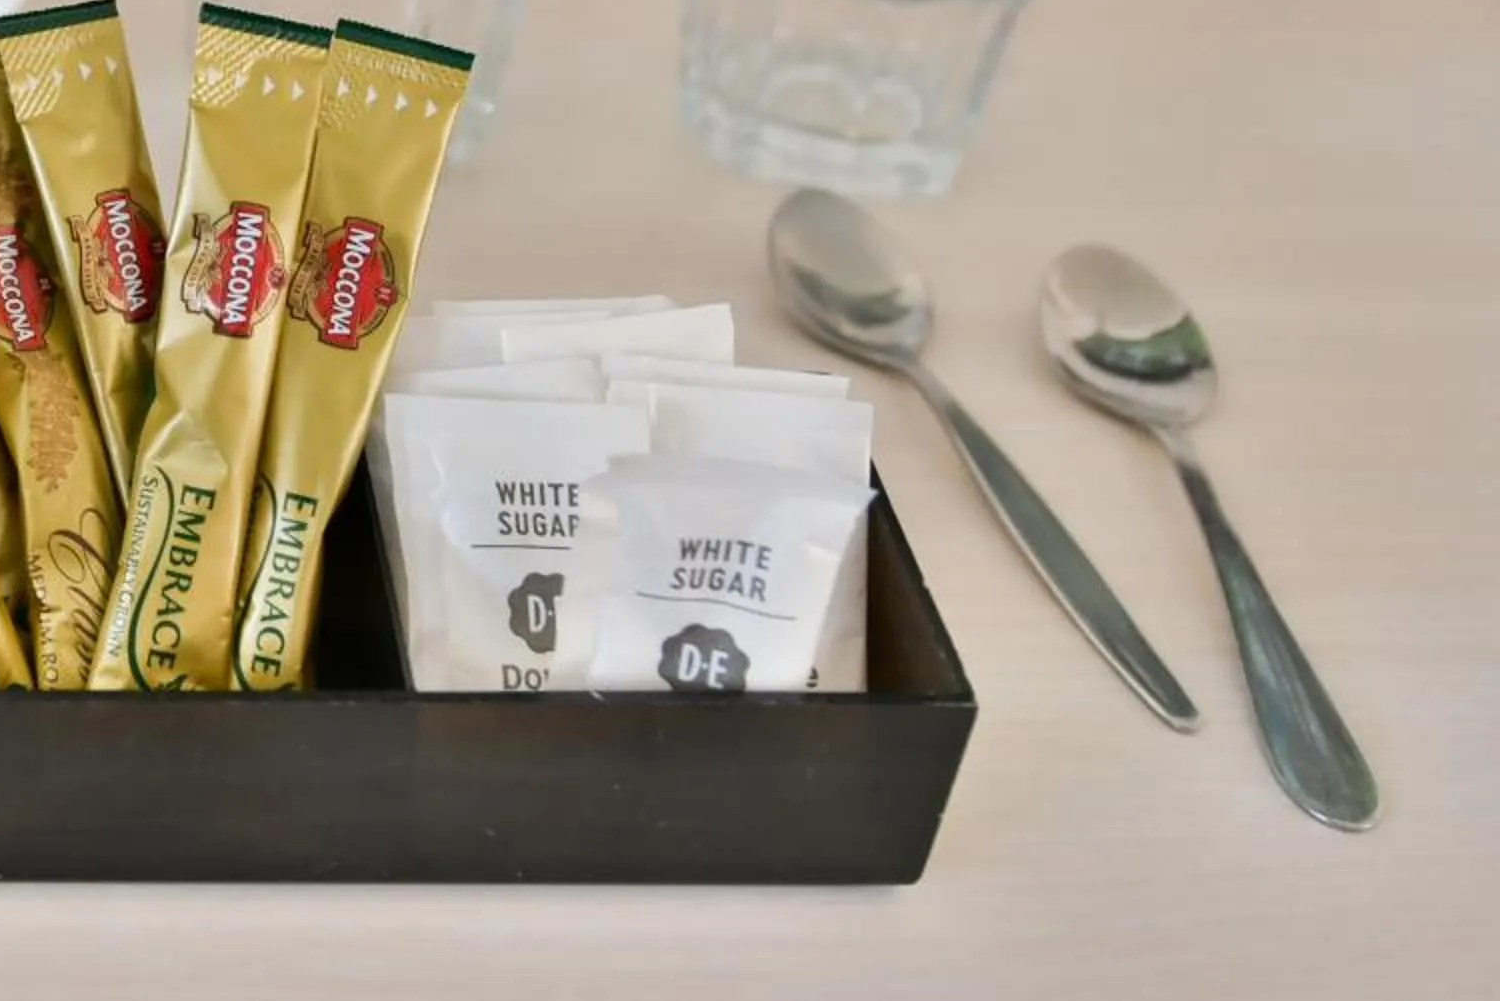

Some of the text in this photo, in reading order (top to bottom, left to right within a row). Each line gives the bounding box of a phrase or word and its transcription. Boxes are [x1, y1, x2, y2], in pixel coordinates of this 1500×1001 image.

[104, 199, 148, 312] MOCCONA
[223, 212, 263, 325] MOCCONA
[328, 228, 375, 336] MOCCONA
[496, 481, 579, 507] WHITE
[147, 485, 216, 670] EMBRACE
[252, 492, 319, 678] EMBRACE
[670, 567, 767, 602] SUGAR
[679, 538, 772, 571] WHITE
